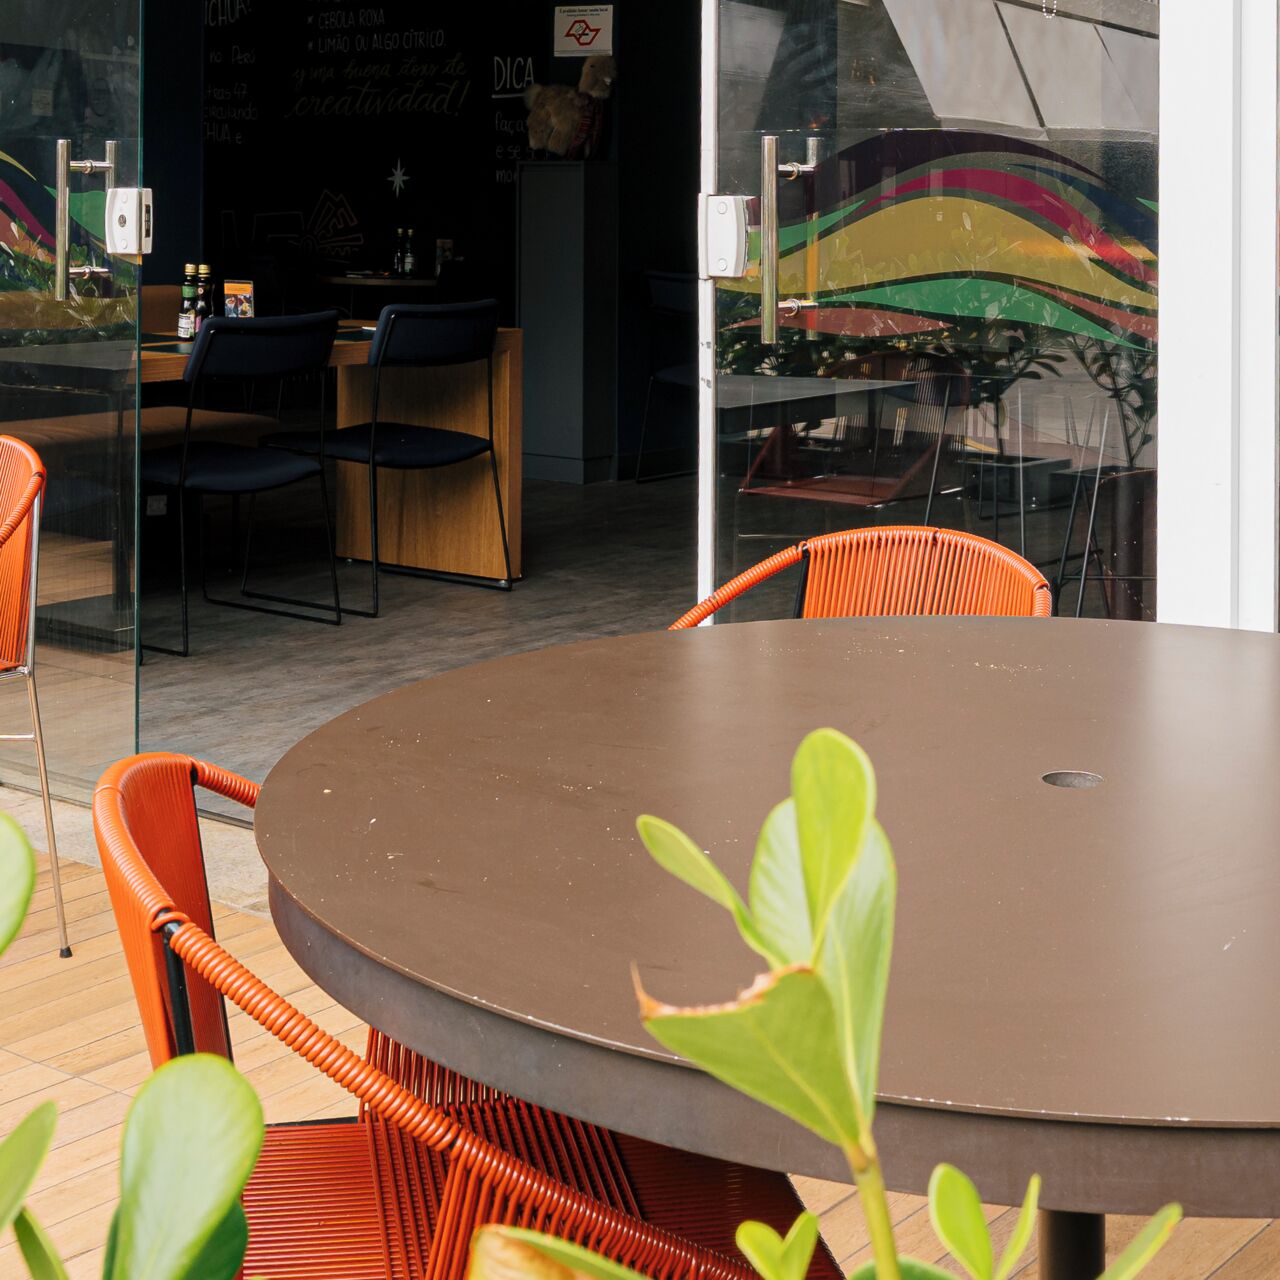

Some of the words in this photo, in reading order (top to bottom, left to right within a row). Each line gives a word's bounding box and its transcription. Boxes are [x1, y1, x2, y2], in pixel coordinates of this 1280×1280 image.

[318, 10, 356, 30] CEBOLA
[359, 7, 386, 29] ROXA
[354, 33, 369, 53] OU
[371, 31, 400, 52] ALGO
[493, 55, 535, 92] DICA
[283, 78, 472, 120] creatividad!
